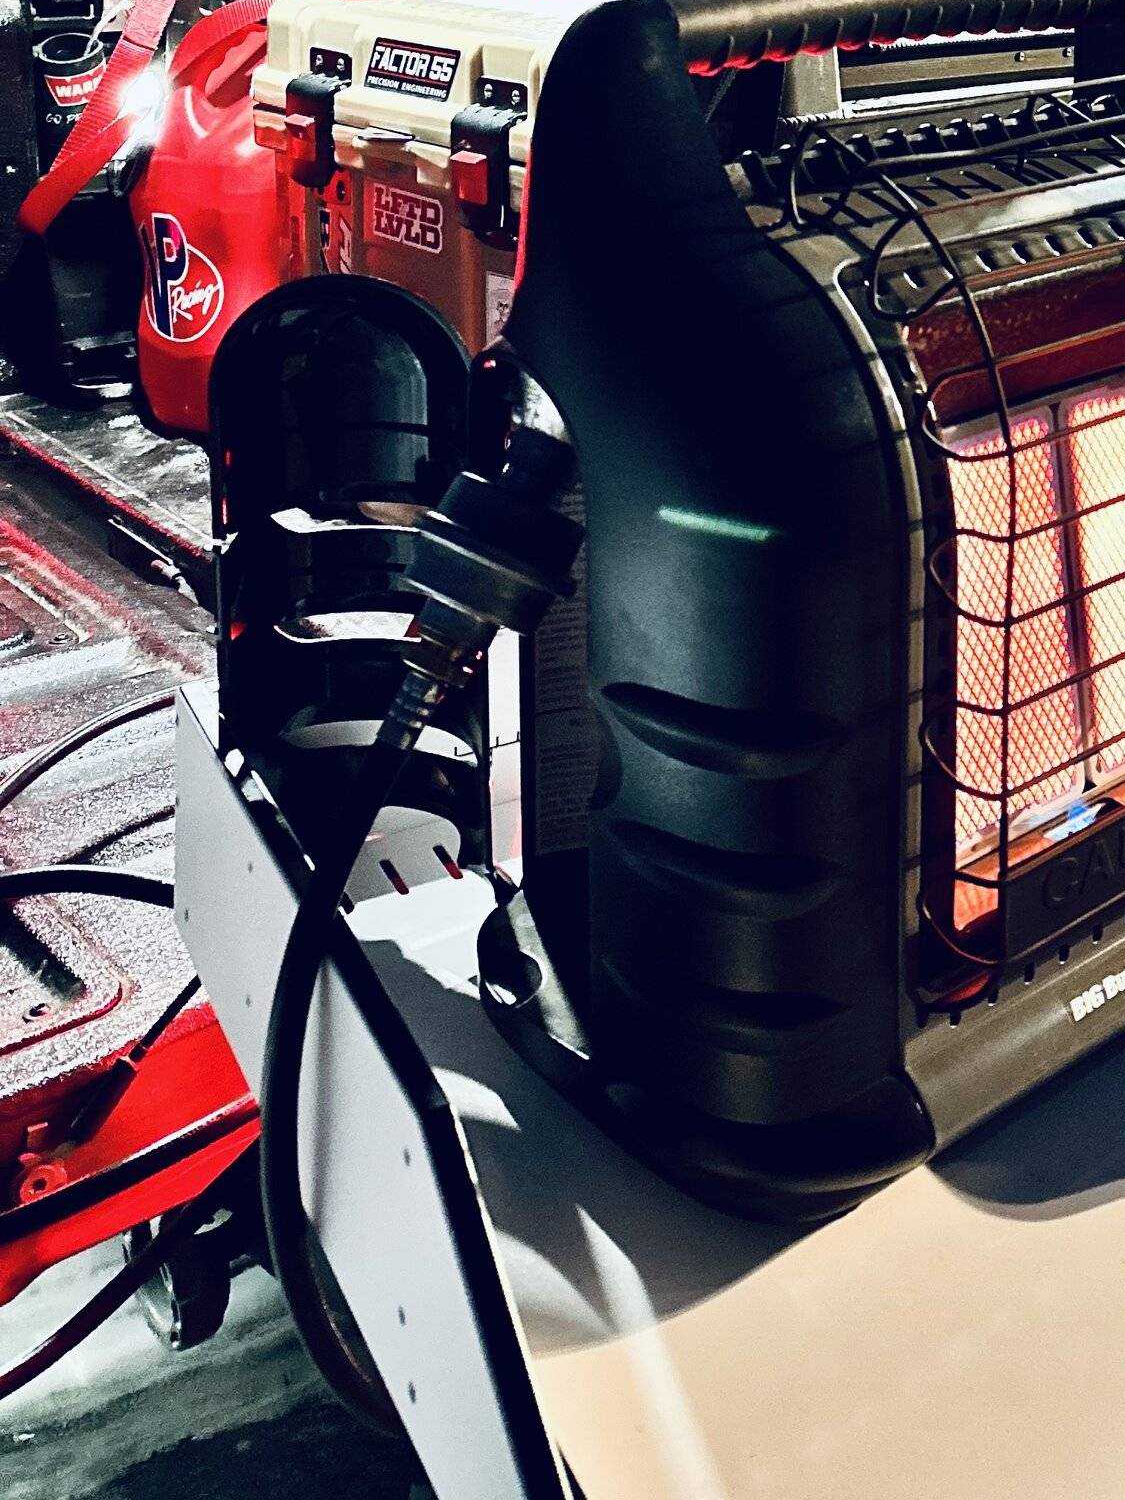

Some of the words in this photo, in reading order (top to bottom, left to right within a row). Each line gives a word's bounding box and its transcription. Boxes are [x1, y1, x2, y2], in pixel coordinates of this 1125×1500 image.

[371, 45, 432, 78] FACTOR
[429, 57, 456, 83] 55
[366, 75, 401, 90] PRECISION
[401, 82, 447, 99] ENGINEERING
[171, 277, 221, 323] Racing
[1068, 985, 1105, 1021] BIG
